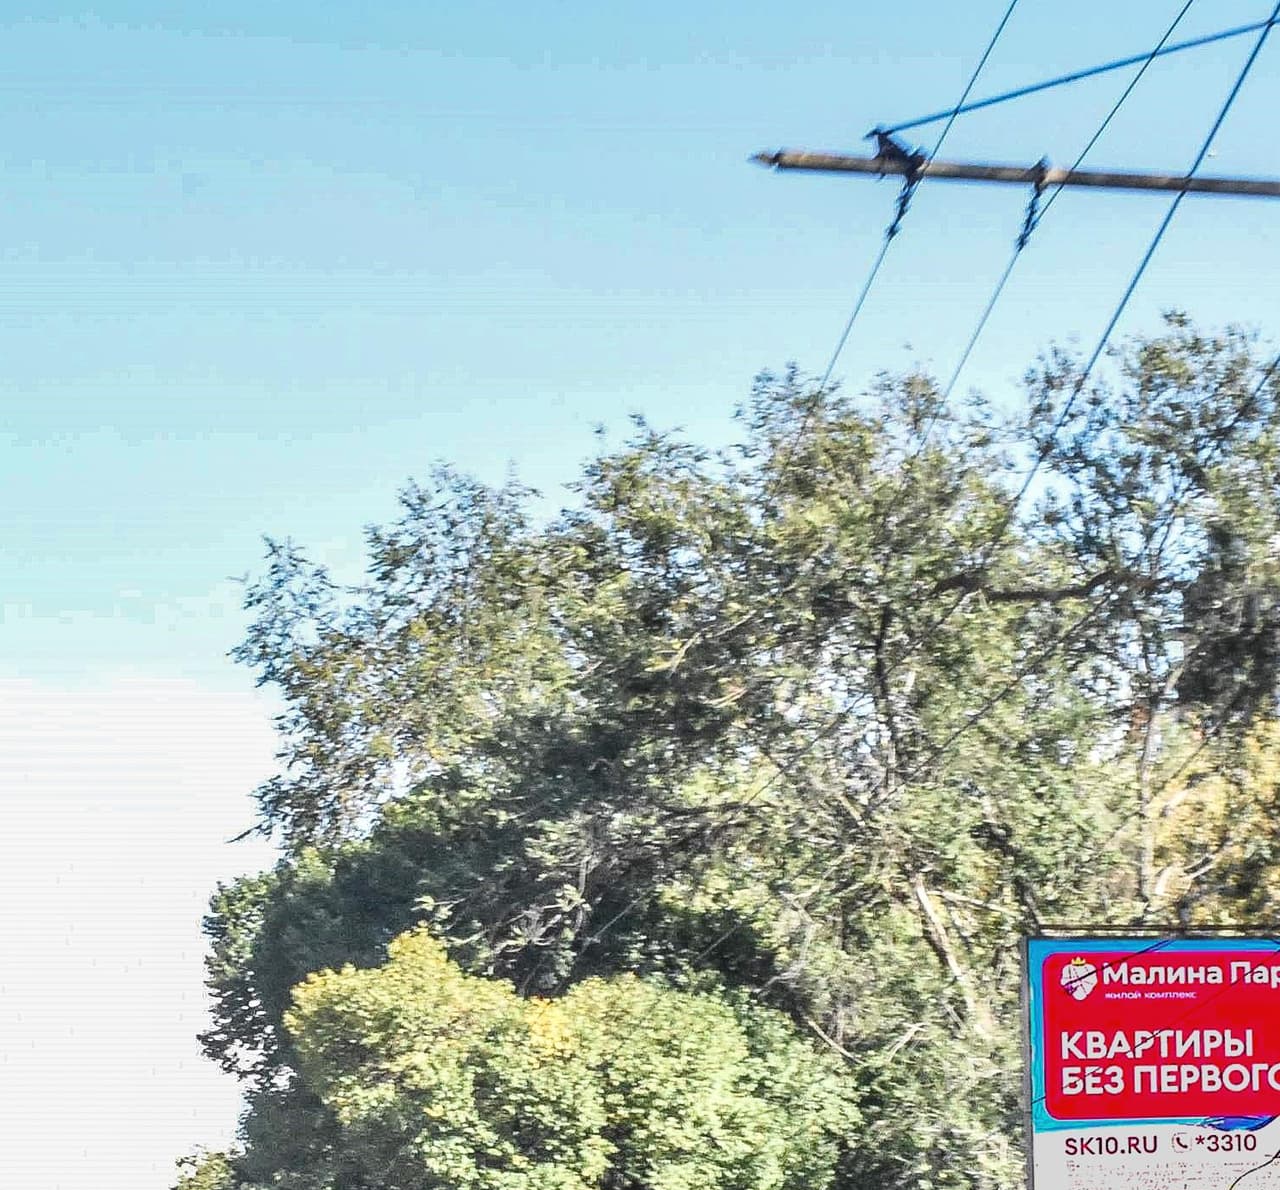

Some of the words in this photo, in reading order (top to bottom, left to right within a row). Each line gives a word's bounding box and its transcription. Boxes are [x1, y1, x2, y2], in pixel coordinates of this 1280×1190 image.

[1102, 962, 1223, 986] Малина
[1061, 1029, 1254, 1060] КВАРТИРЫ
[1062, 1066, 1125, 1095] БЕЗ
[1065, 1135, 1158, 1155] SK10.RU
